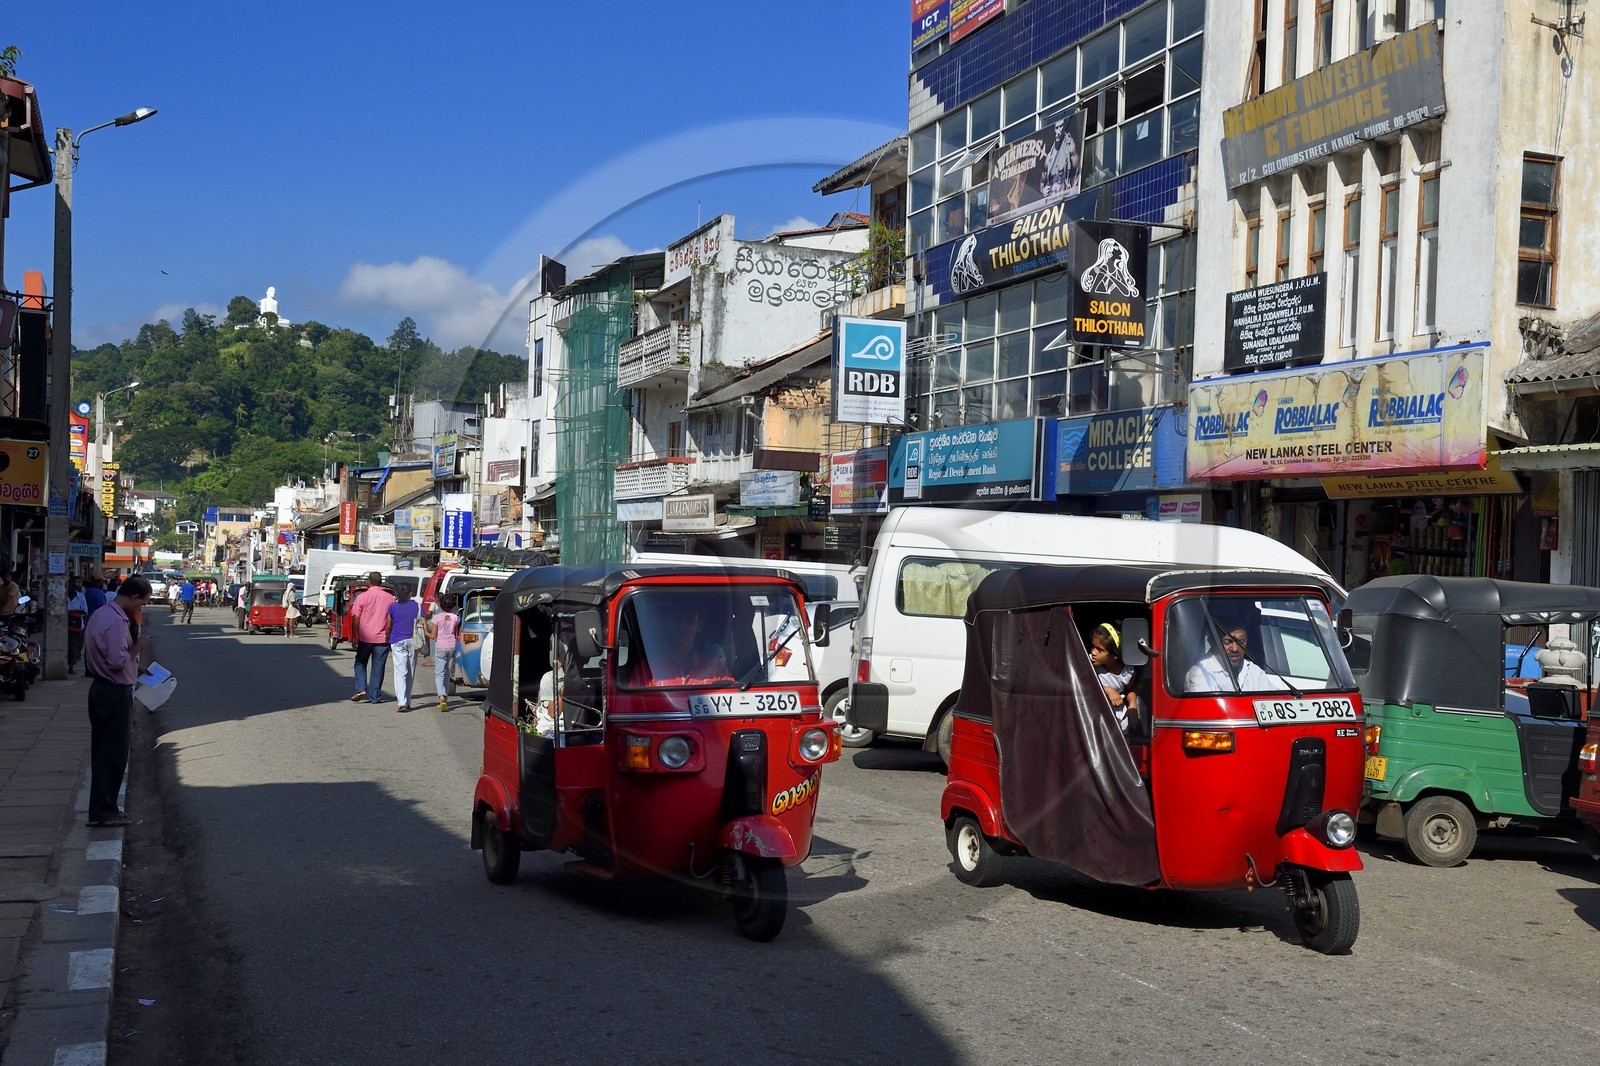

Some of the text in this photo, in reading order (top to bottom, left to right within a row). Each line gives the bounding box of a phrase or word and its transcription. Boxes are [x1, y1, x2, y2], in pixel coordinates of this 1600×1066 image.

[921, 10, 939, 30] ICT
[1303, 25, 1432, 108] INVESTMENT
[1285, 82, 1391, 148] FINANCE
[1364, 120, 1390, 138] PHONE
[997, 140, 1043, 172] WINNERS
[1001, 157, 1036, 181] GYMNASIUM
[1011, 203, 1065, 239] SALON
[989, 223, 1069, 270] THILOTHAM
[1232, 290, 1256, 302] NISSANKA
[1089, 300, 1131, 317] SALON
[1263, 308, 1293, 319] DODANWELA
[1074, 317, 1145, 336] THILOTHAMA
[1242, 339, 1268, 350] SUNANDA
[848, 371, 896, 394] RDB
[1274, 402, 1339, 434] ROBBIALAC
[1368, 392, 1445, 427] ROBBIALAC
[1088, 414, 1153, 447] MIRACLE
[1195, 411, 1250, 440] ROBBIALAC
[28, 449, 38, 457] 27
[1087, 447, 1152, 471] COLLEGE
[1246, 440, 1392, 460] NEW LANKA STEEL CENTER
[840, 466, 848, 475] GEM
[853, 463, 878, 473] JEWELLERY
[907, 466, 918, 479] RDB
[929, 463, 997, 480] Regiol Develment Bank
[0, 483, 40, 501] වලගිරි
[1337, 476, 1498, 491] NEW LANKA STEEL CENTRE
[754, 694, 798, 711] 3269
[1274, 702, 1297, 719] QS
[1312, 700, 1354, 718] 2882
